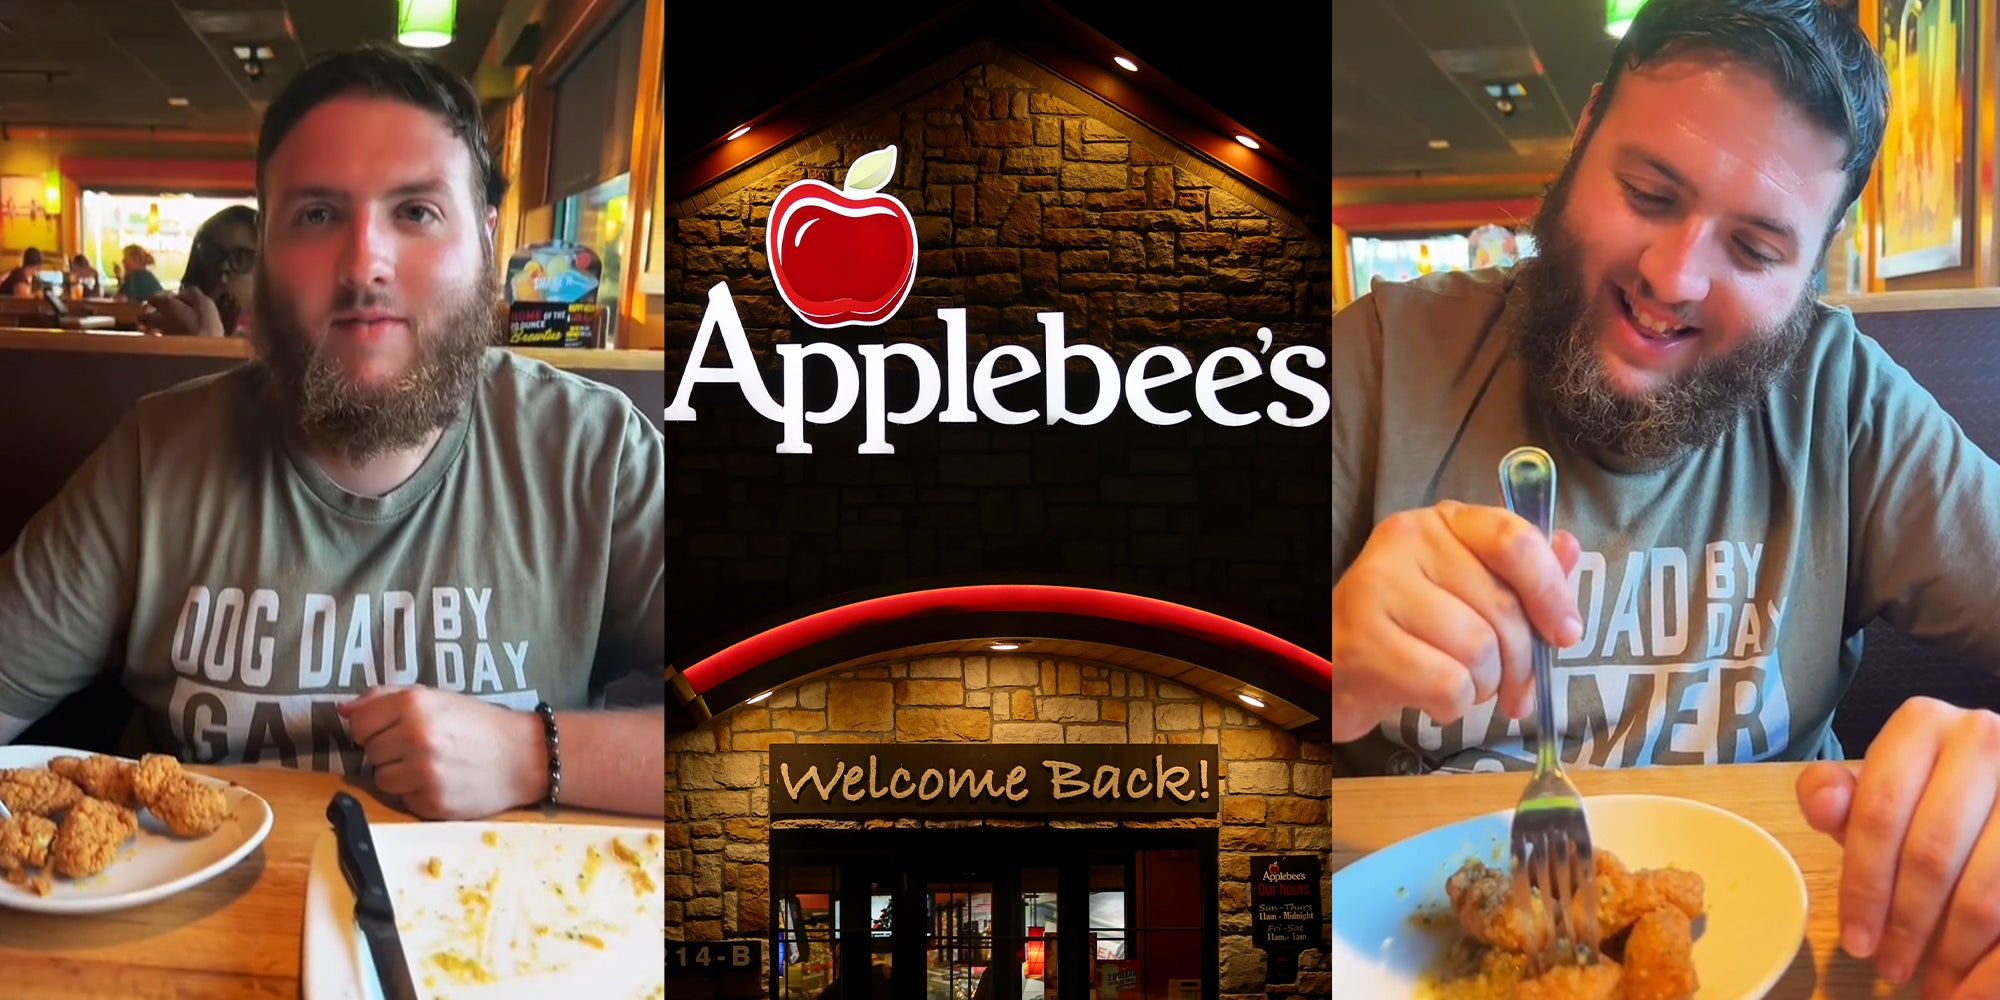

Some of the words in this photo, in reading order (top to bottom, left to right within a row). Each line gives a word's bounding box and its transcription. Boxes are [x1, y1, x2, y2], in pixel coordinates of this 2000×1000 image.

[519, 319, 546, 330] OUNCE
[543, 311, 552, 320] OF
[553, 311, 566, 320] THE
[664, 280, 1331, 454] Applebee's
[1556, 545, 1690, 661] DAD
[1706, 540, 1763, 599] BY
[171, 585, 280, 688] DOG
[299, 590, 418, 689] DAD
[432, 586, 492, 641] BY
[1707, 597, 1789, 659] DAY
[435, 640, 530, 693] DAY
[780, 755, 1029, 801] Welcome
[1043, 758, 1211, 801] Back!
[1257, 883, 1277, 897] Our
[1262, 870, 1306, 883] Applebee's
[1259, 912, 1277, 921] 11am
[1283, 911, 1314, 921] Midnight
[665, 945, 751, 967] 14-B
